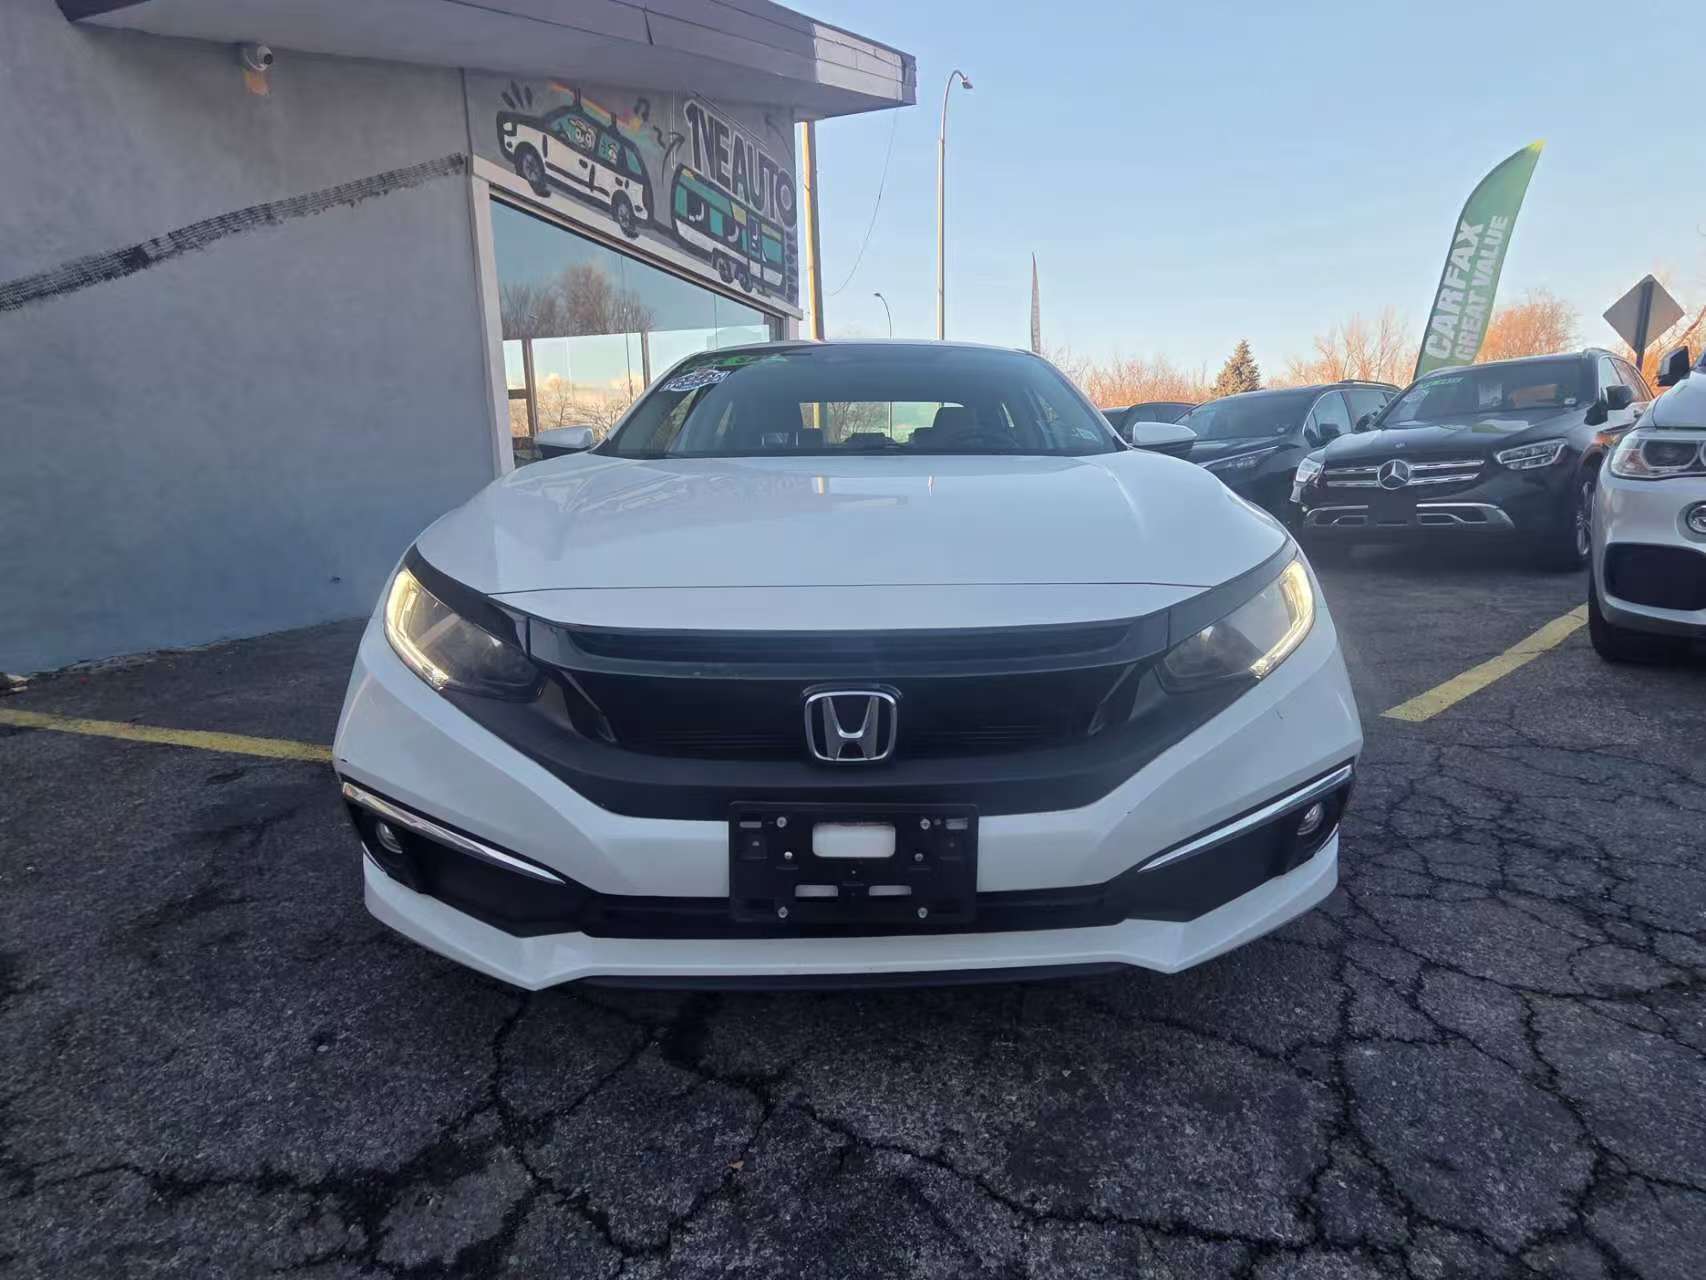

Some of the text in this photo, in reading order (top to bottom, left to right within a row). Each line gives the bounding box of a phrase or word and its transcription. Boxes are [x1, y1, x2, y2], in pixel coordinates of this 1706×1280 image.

[1425, 219, 1484, 360] CARFAX
[1455, 216, 1508, 361] GREAT VALUE
